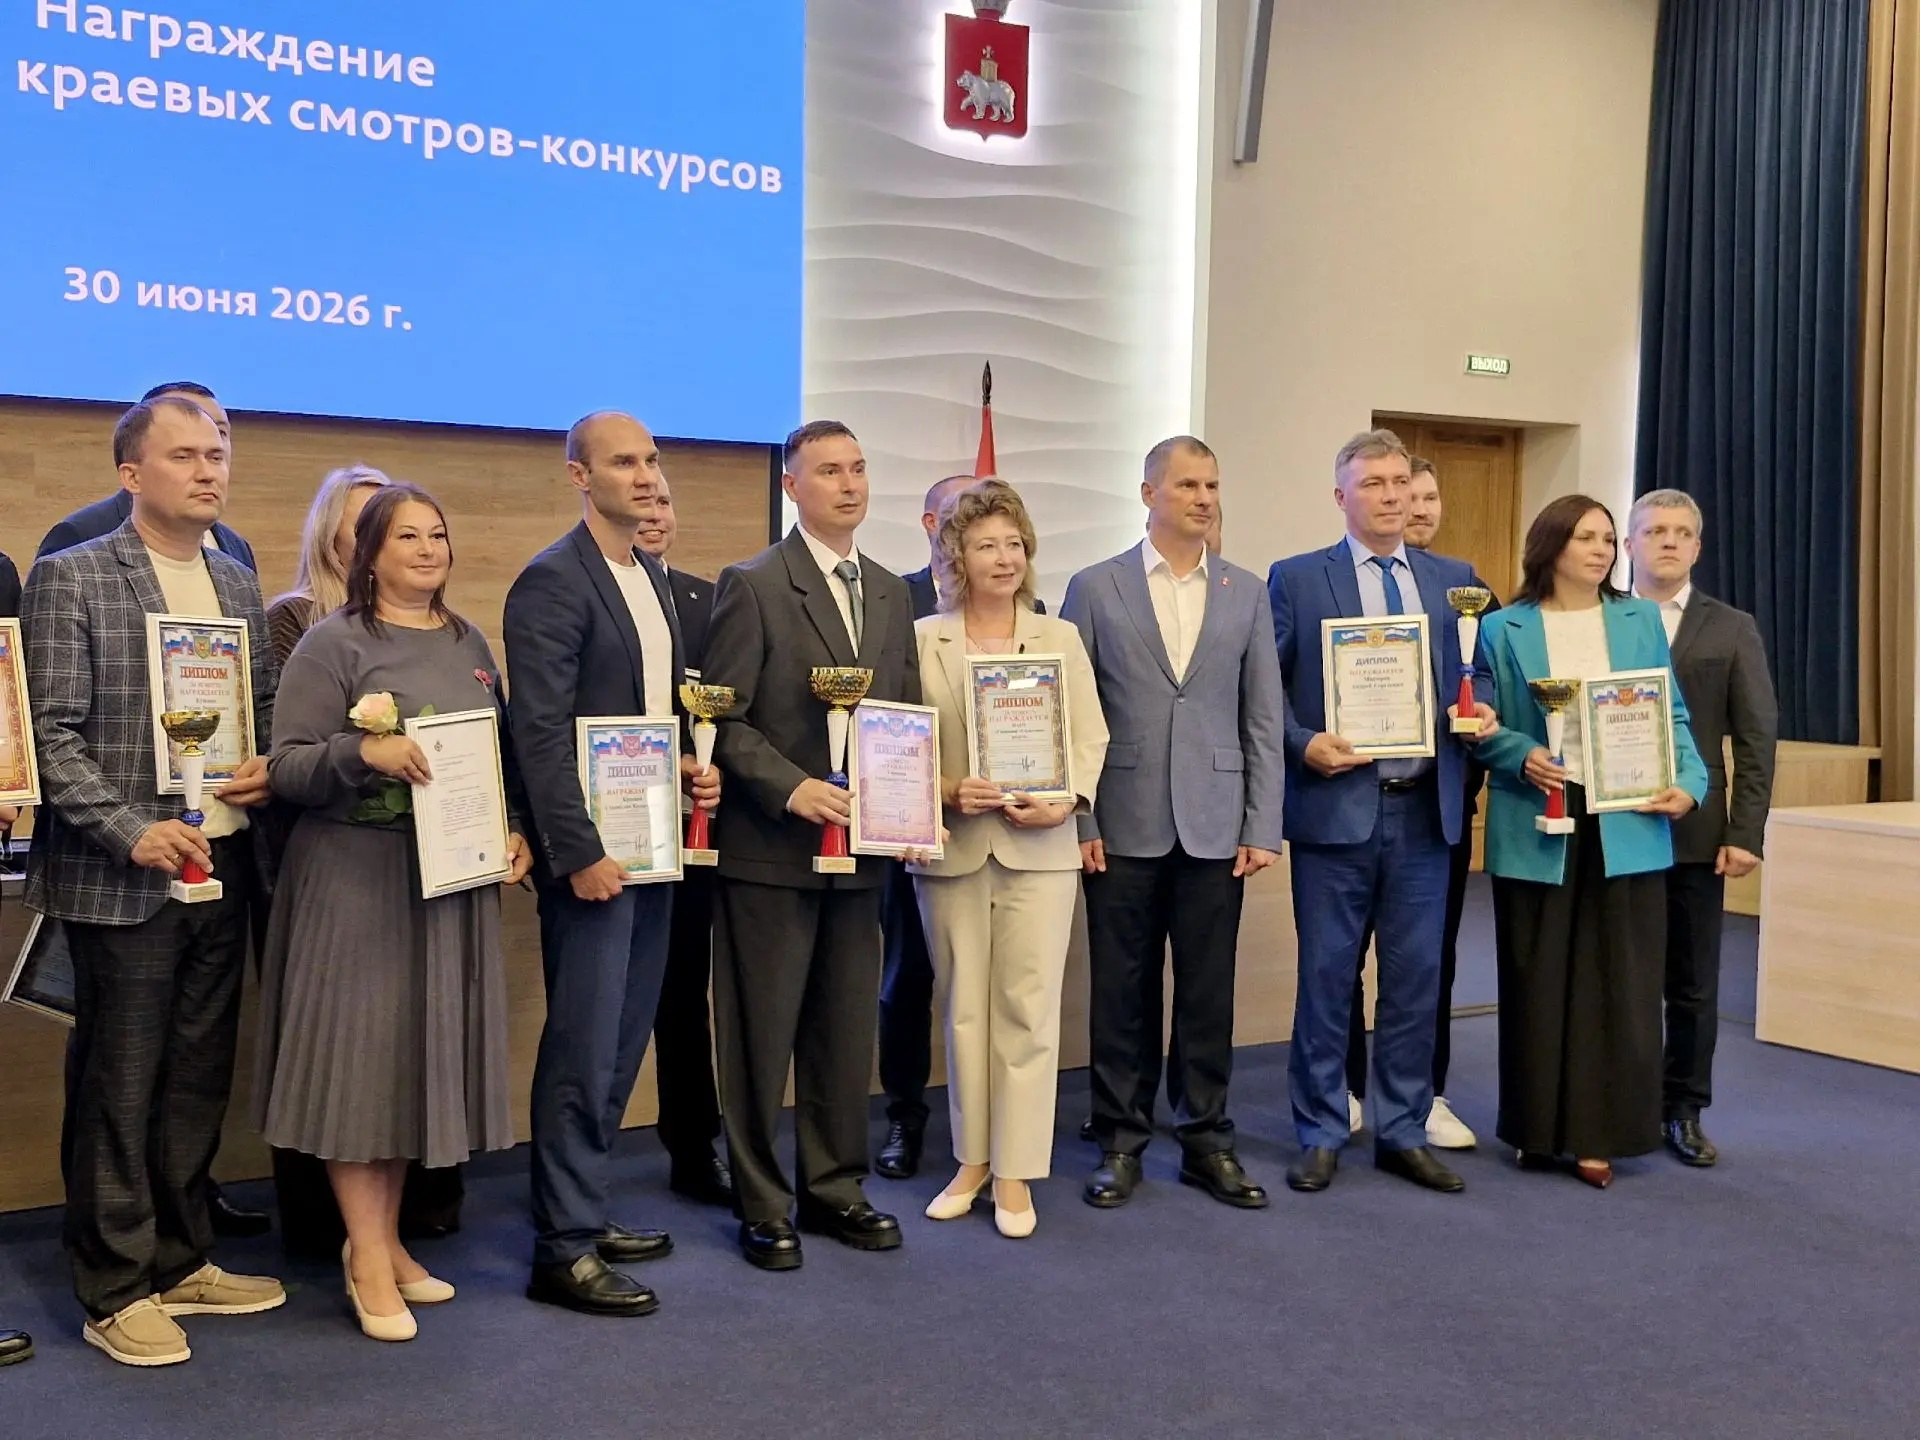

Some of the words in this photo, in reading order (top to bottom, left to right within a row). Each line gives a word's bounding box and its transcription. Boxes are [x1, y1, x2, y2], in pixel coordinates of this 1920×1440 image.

[37, 0, 435, 87] Награждение
[17, 59, 272, 125] краевых
[289, 99, 782, 193] смотров-конкурсов
[63, 267, 121, 304] 30
[137, 281, 257, 317] июня
[271, 287, 371, 326] 2026
[384, 305, 412, 330] г.
[1471, 356, 1507, 373] ВЫХОД
[1355, 656, 1398, 667] ДИПЛОМ
[179, 665, 229, 680] ДИПЛОМ
[992, 696, 1044, 709] ДИПЛОМ
[1606, 711, 1649, 724] ДИПЛОМ
[607, 765, 658, 779] ДИПЛОМ
